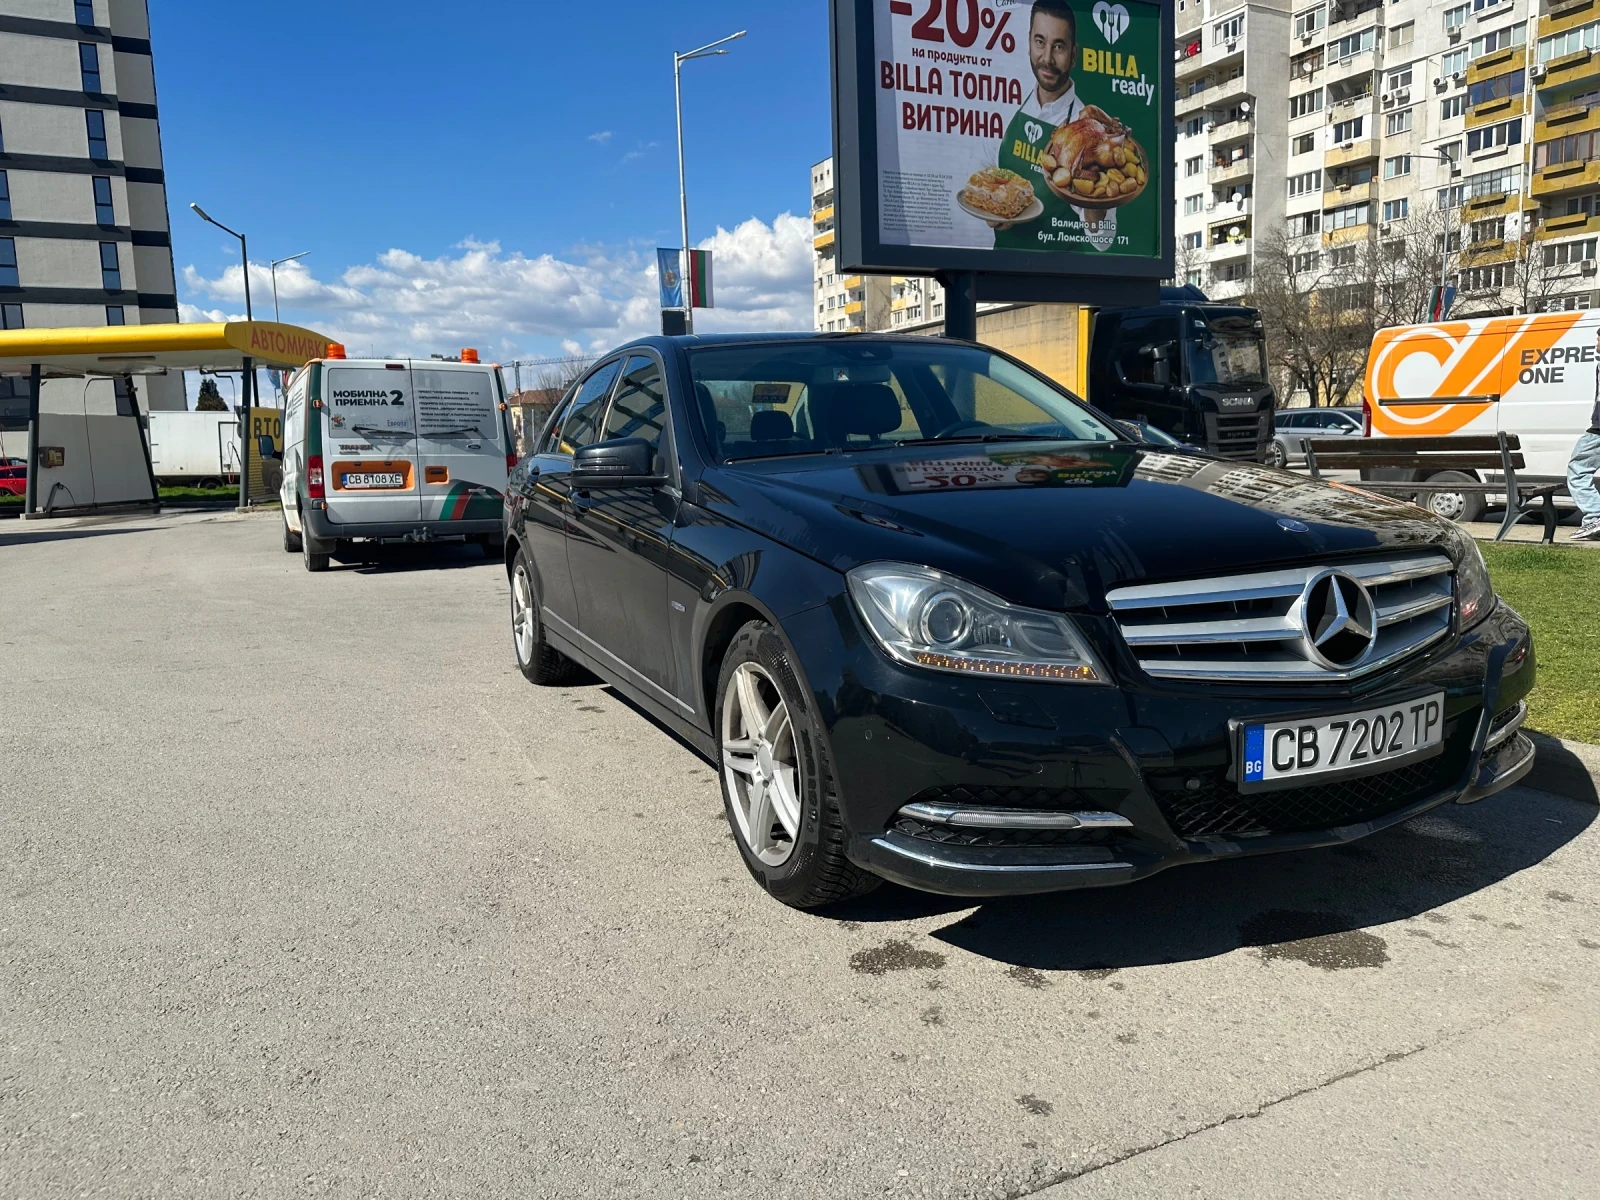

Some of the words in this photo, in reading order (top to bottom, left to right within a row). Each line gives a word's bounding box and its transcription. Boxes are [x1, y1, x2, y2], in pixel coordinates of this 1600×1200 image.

[890, 0, 1016, 53] -20%
[912, 48, 925, 58] на
[928, 50, 978, 66] продукти
[980, 57, 992, 67] от
[1083, 48, 1139, 78] BILLA
[881, 61, 942, 95] BILLA
[949, 70, 1022, 105] ТОПЛА
[1112, 74, 1155, 106] ready
[903, 102, 1003, 139] ВИТРИНА
[1051, 217, 1089, 229] Валидно
[1098, 220, 1117, 230] Billa
[1038, 231, 1055, 243] бул.
[1057, 232, 1091, 243] Ломско
[1092, 236, 1114, 244] шосе
[1117, 236, 1129, 245] 171
[1519, 367, 1564, 384] ONE
[333, 390, 388, 398] МОБИЛНА
[389, 389, 404, 406] 2
[335, 398, 388, 406] ПРИЕМНА
[1222, 397, 1254, 406] SCANIA
[250, 417, 280, 439] ВТО
[348, 474, 362, 484] CB
[363, 474, 387, 484] 8108
[388, 474, 402, 484] XE
[1271, 725, 1320, 772] CB
[1328, 710, 1404, 766] 7202
[1410, 700, 1440, 746] TP
[1246, 761, 1261, 774] BG
